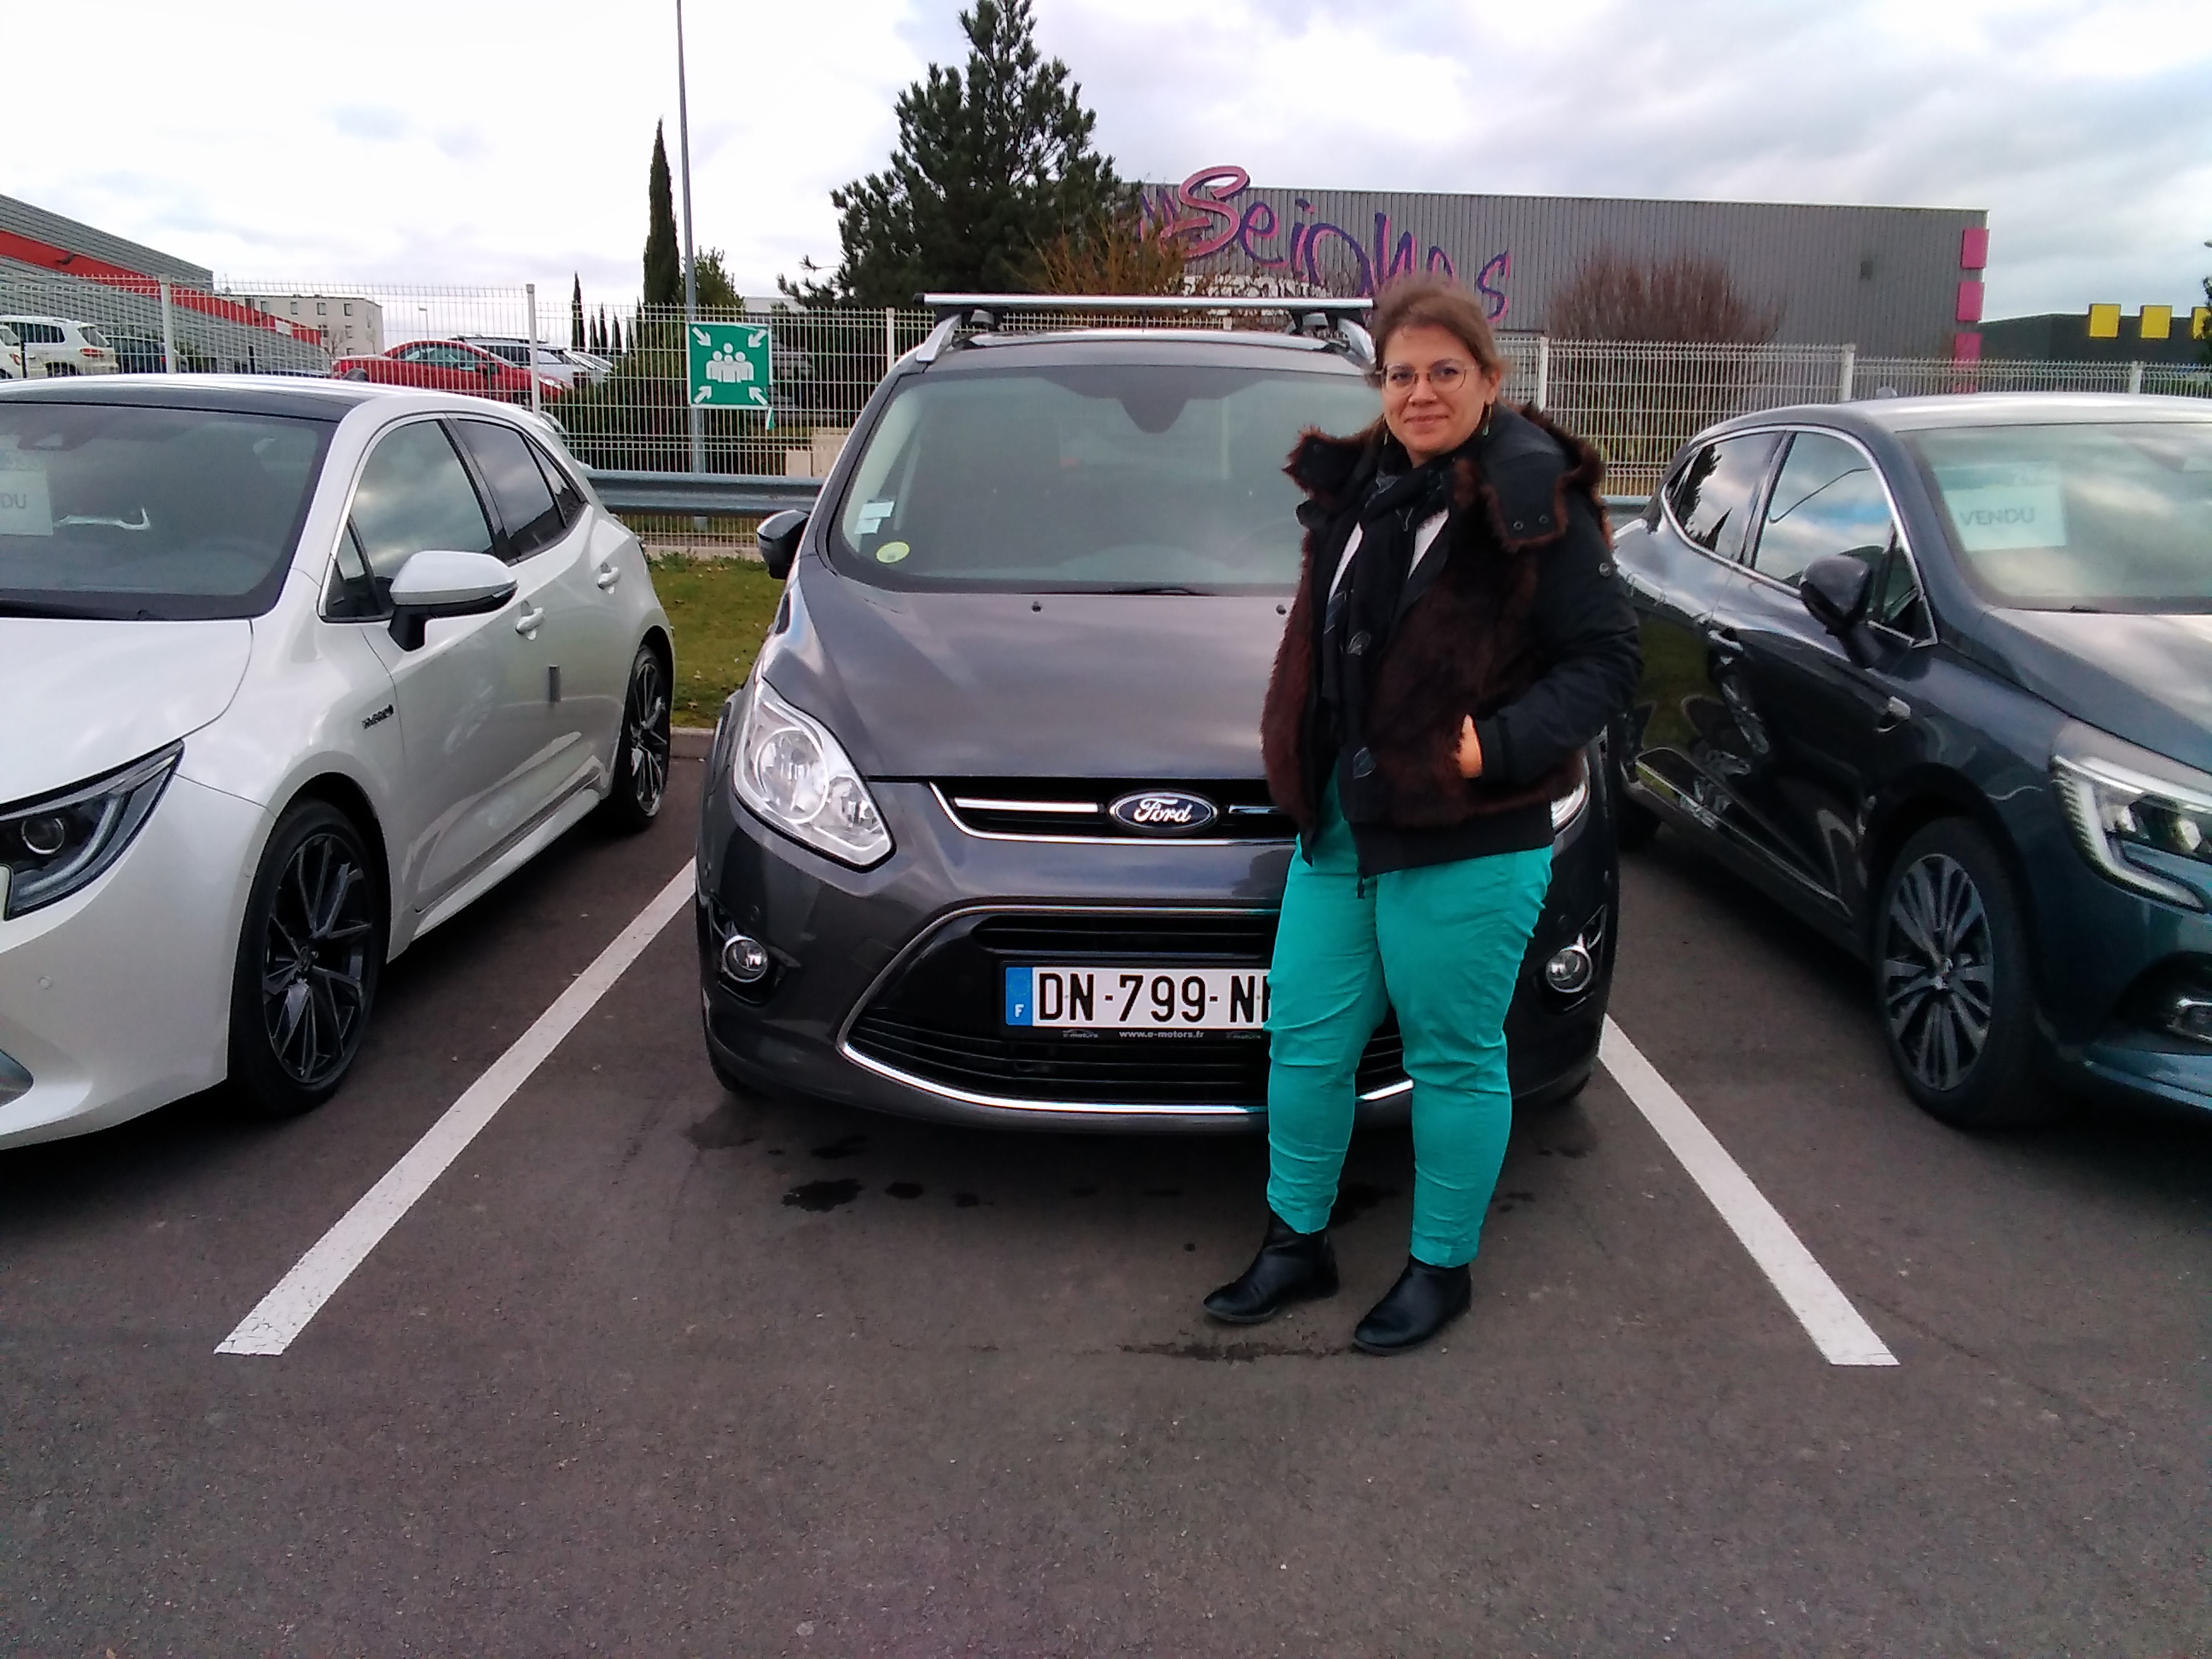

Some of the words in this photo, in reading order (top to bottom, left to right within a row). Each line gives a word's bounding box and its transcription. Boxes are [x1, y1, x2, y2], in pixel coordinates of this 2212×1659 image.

[1959, 508, 2036, 527] VENDU
[1133, 798, 1194, 823] Ford
[1038, 972, 1268, 1024] DN-799-N
[1014, 1004, 1025, 1018] F
